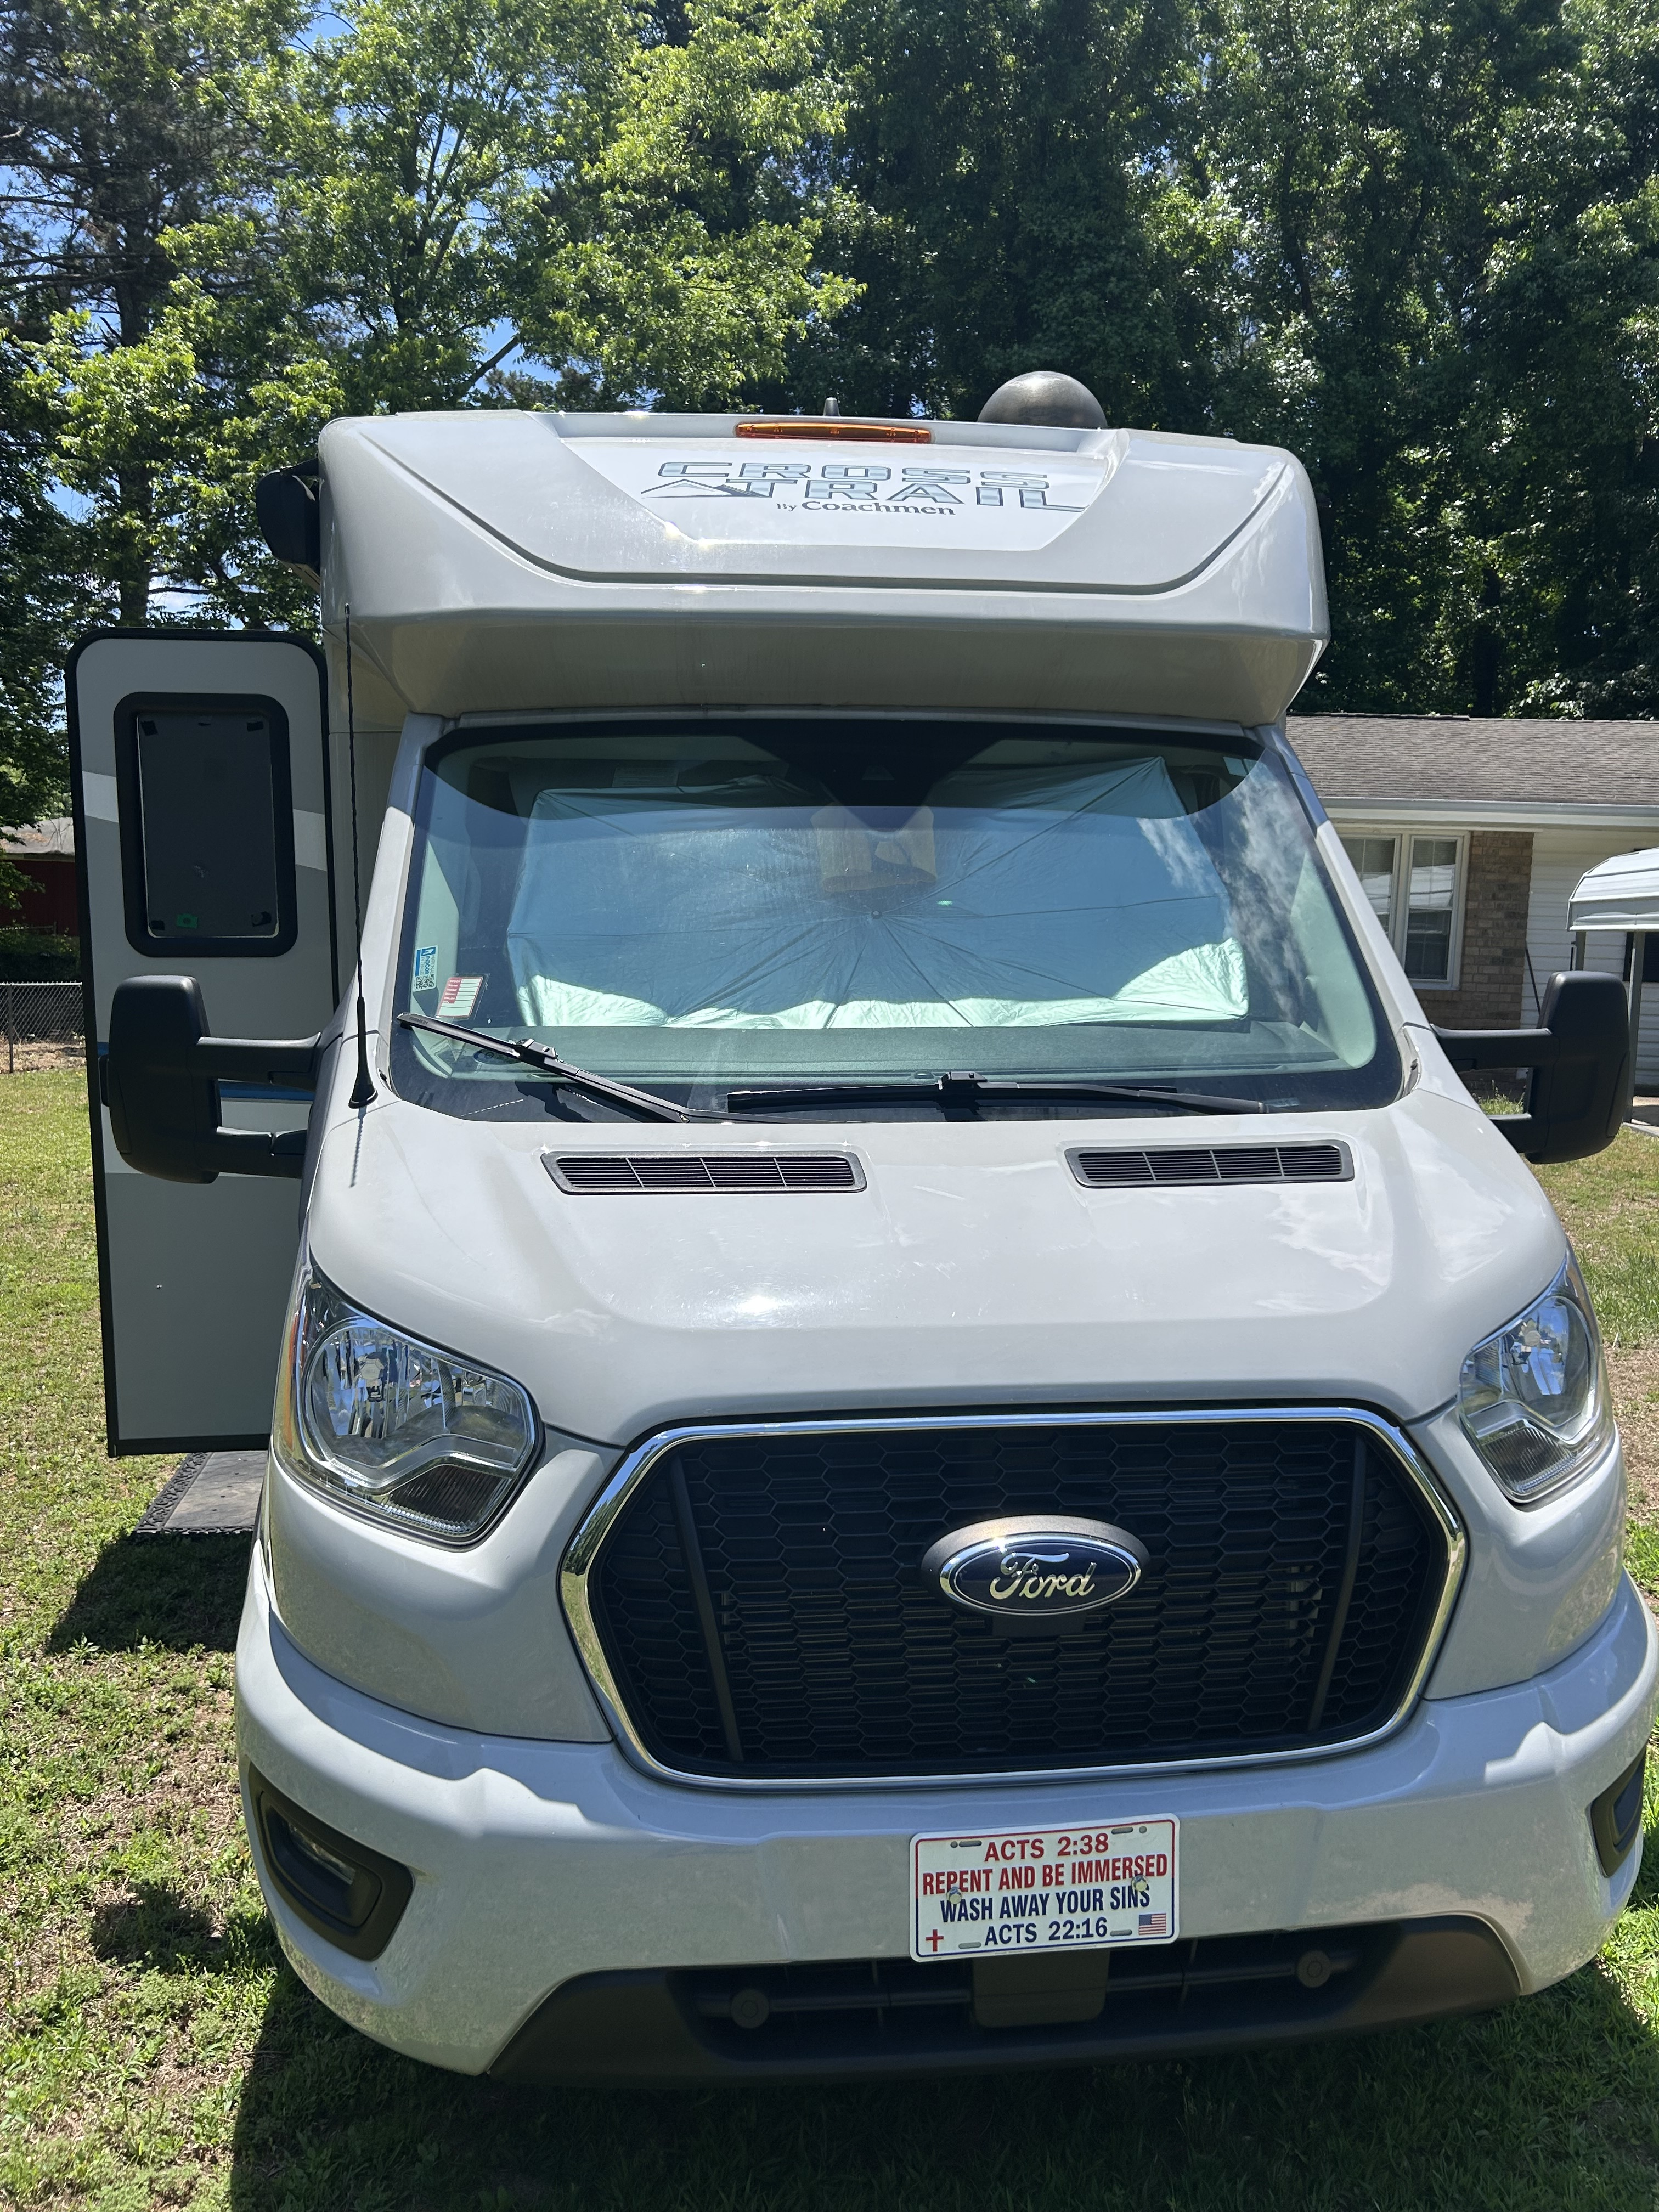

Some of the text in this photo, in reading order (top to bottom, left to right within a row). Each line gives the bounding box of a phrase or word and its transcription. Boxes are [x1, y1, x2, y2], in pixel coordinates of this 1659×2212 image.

[657, 462, 1050, 489] CROSS
[725, 479, 1090, 512] TRAIL
[776, 500, 957, 516] By Coachmen
[990, 1552, 1097, 1600] Ford
[984, 1833, 1109, 1862] ACTS 2:38
[923, 1854, 1167, 1895] REPENT AND BE IMMERSED
[940, 1884, 1150, 1923] WASH AWAY YOUR SINS
[985, 1917, 1108, 1946] ACTS 22:16
